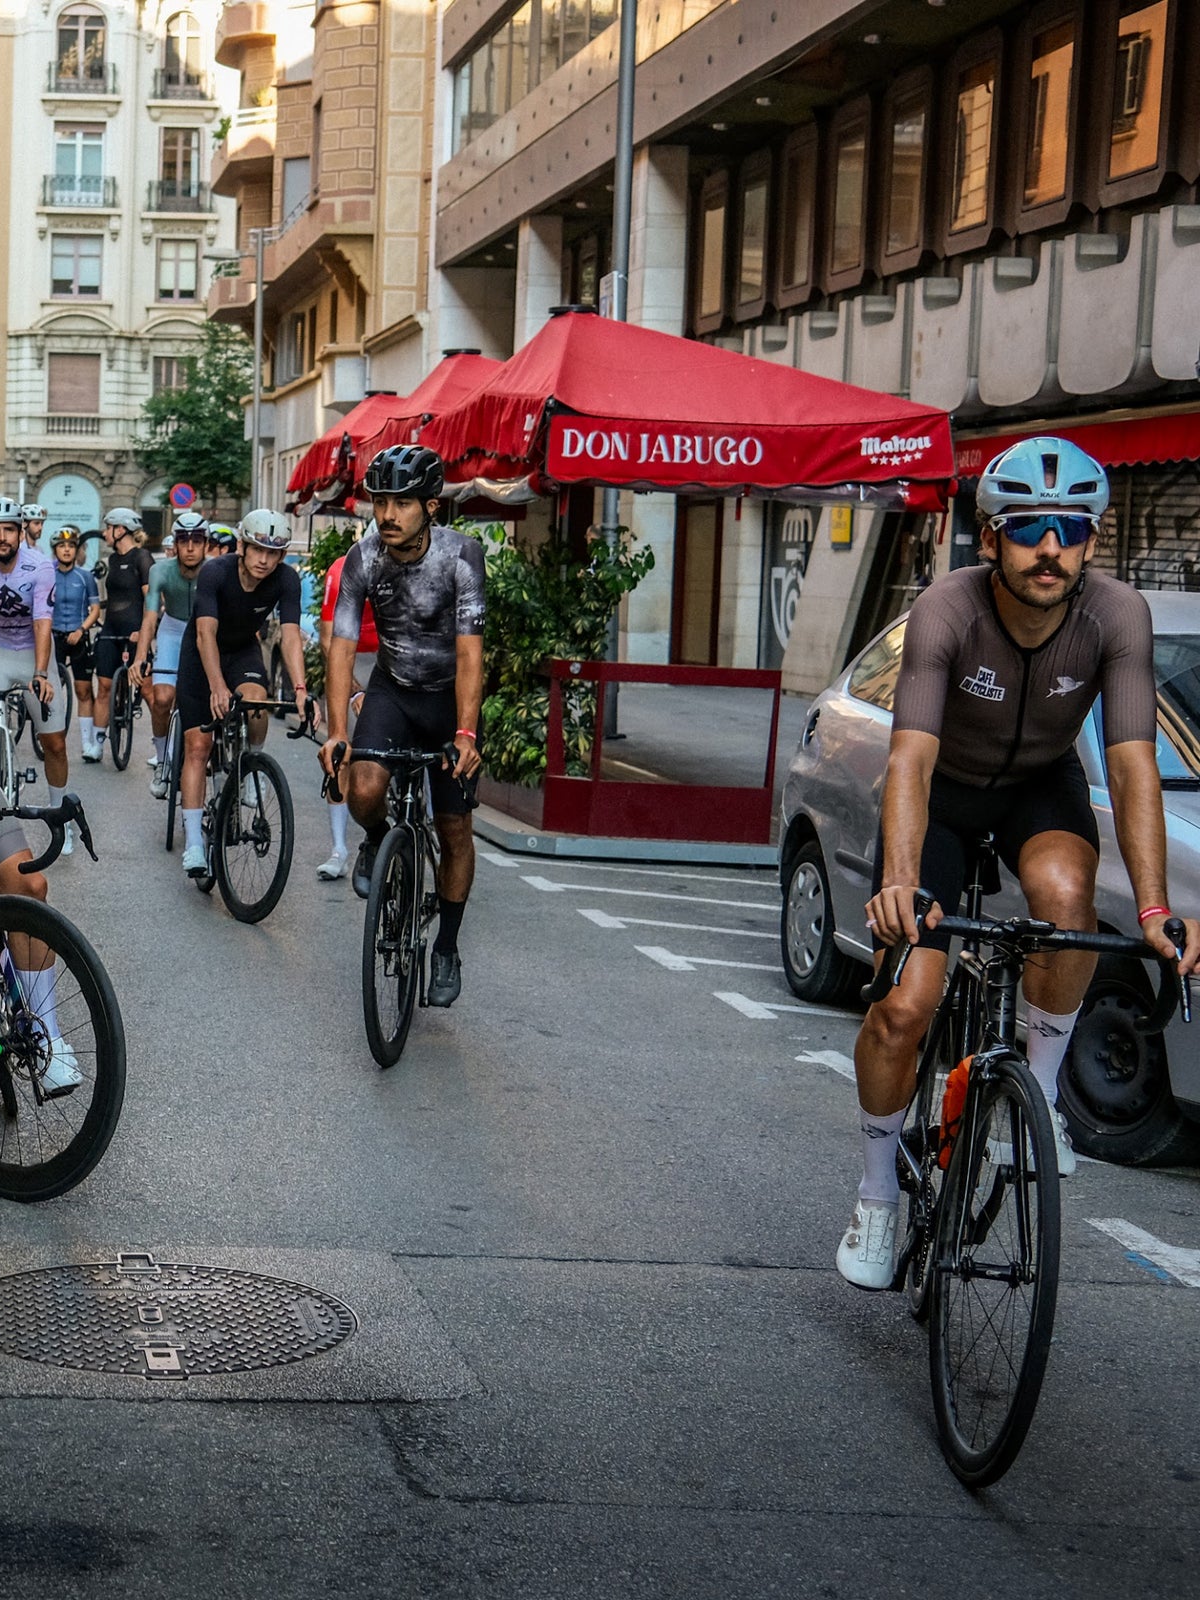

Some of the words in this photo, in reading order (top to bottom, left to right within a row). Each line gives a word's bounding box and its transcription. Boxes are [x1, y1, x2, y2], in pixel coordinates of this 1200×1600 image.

[561, 428, 630, 461] DON
[637, 433, 764, 466] JABUGO
[860, 435, 932, 456] Mahou
[971, 682, 1003, 700] CYCLISTE
